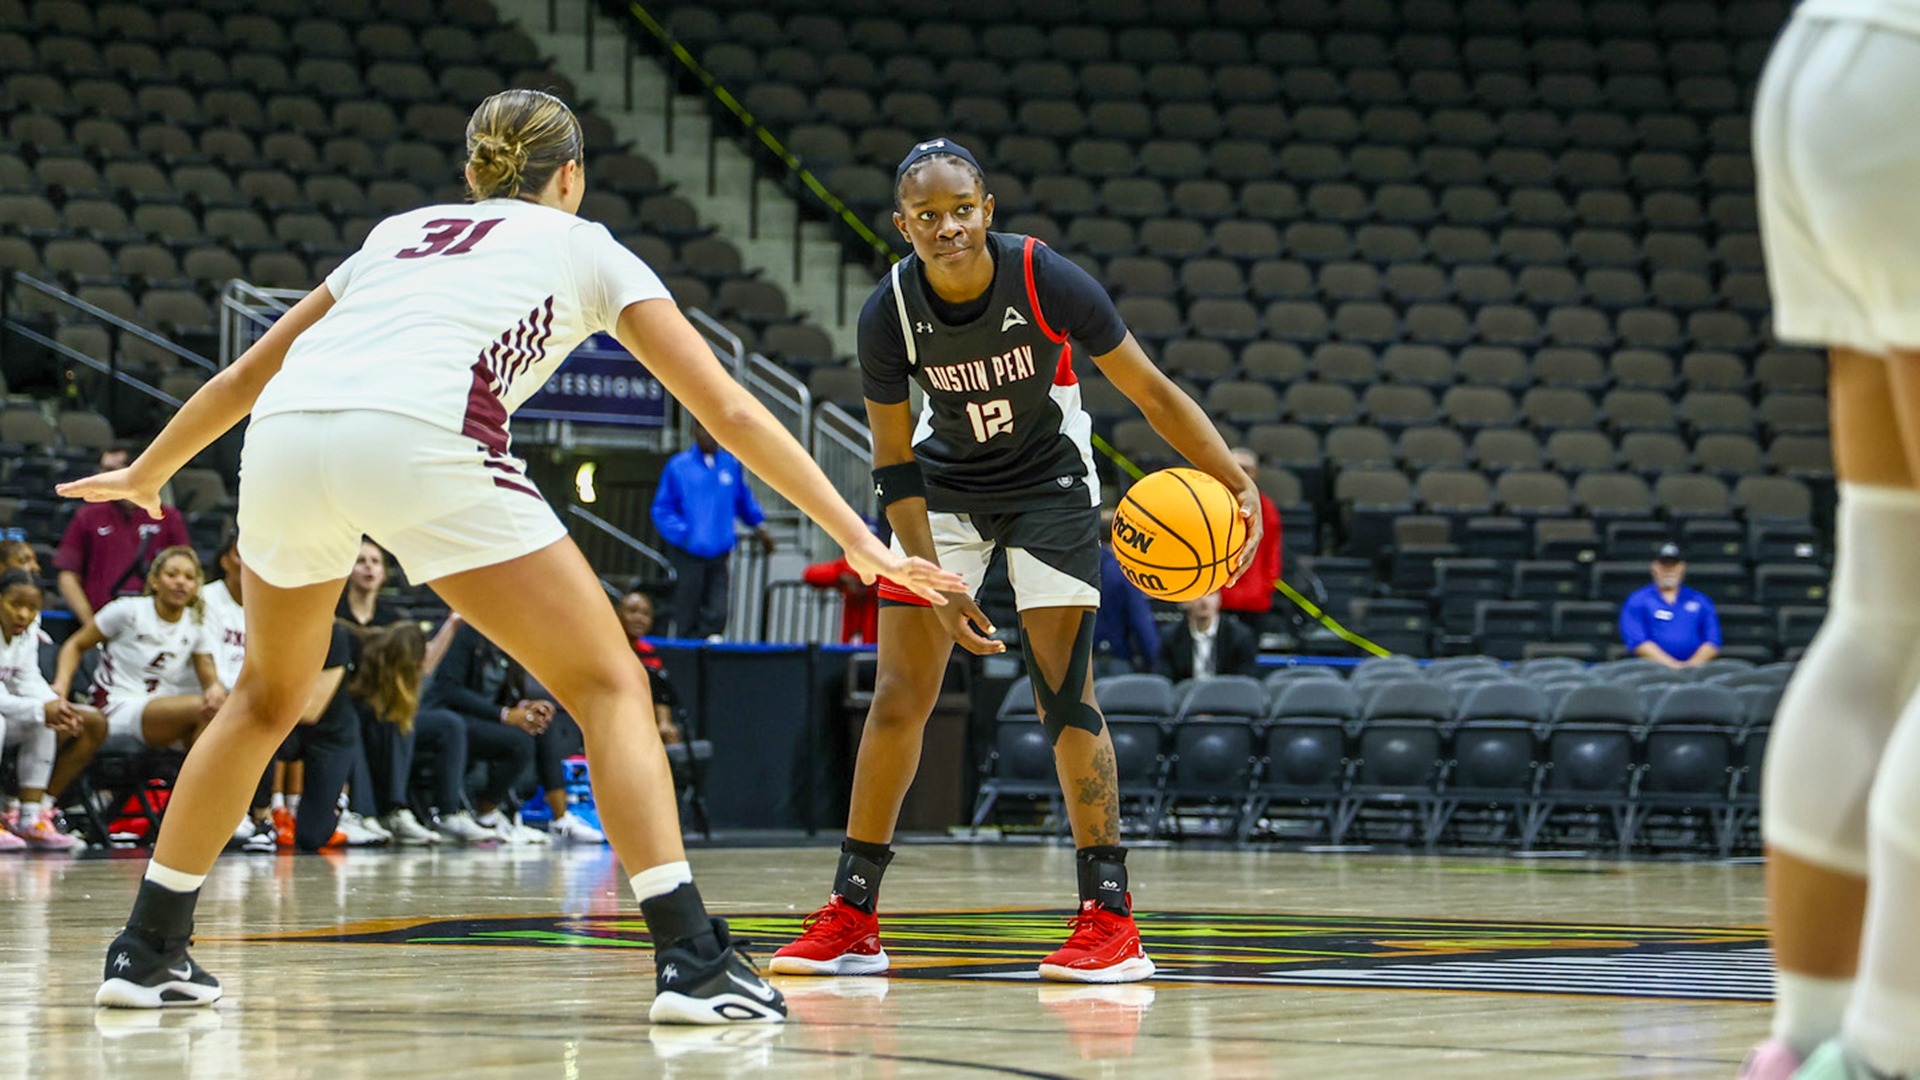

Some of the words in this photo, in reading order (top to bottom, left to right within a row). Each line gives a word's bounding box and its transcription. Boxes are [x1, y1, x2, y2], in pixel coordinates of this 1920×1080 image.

[395, 217, 507, 259] 31
[924, 359, 991, 392] AUSTIN
[990, 344, 1037, 387] PEAY
[965, 398, 1015, 444] 12
[1113, 510, 1154, 554] NCAA
